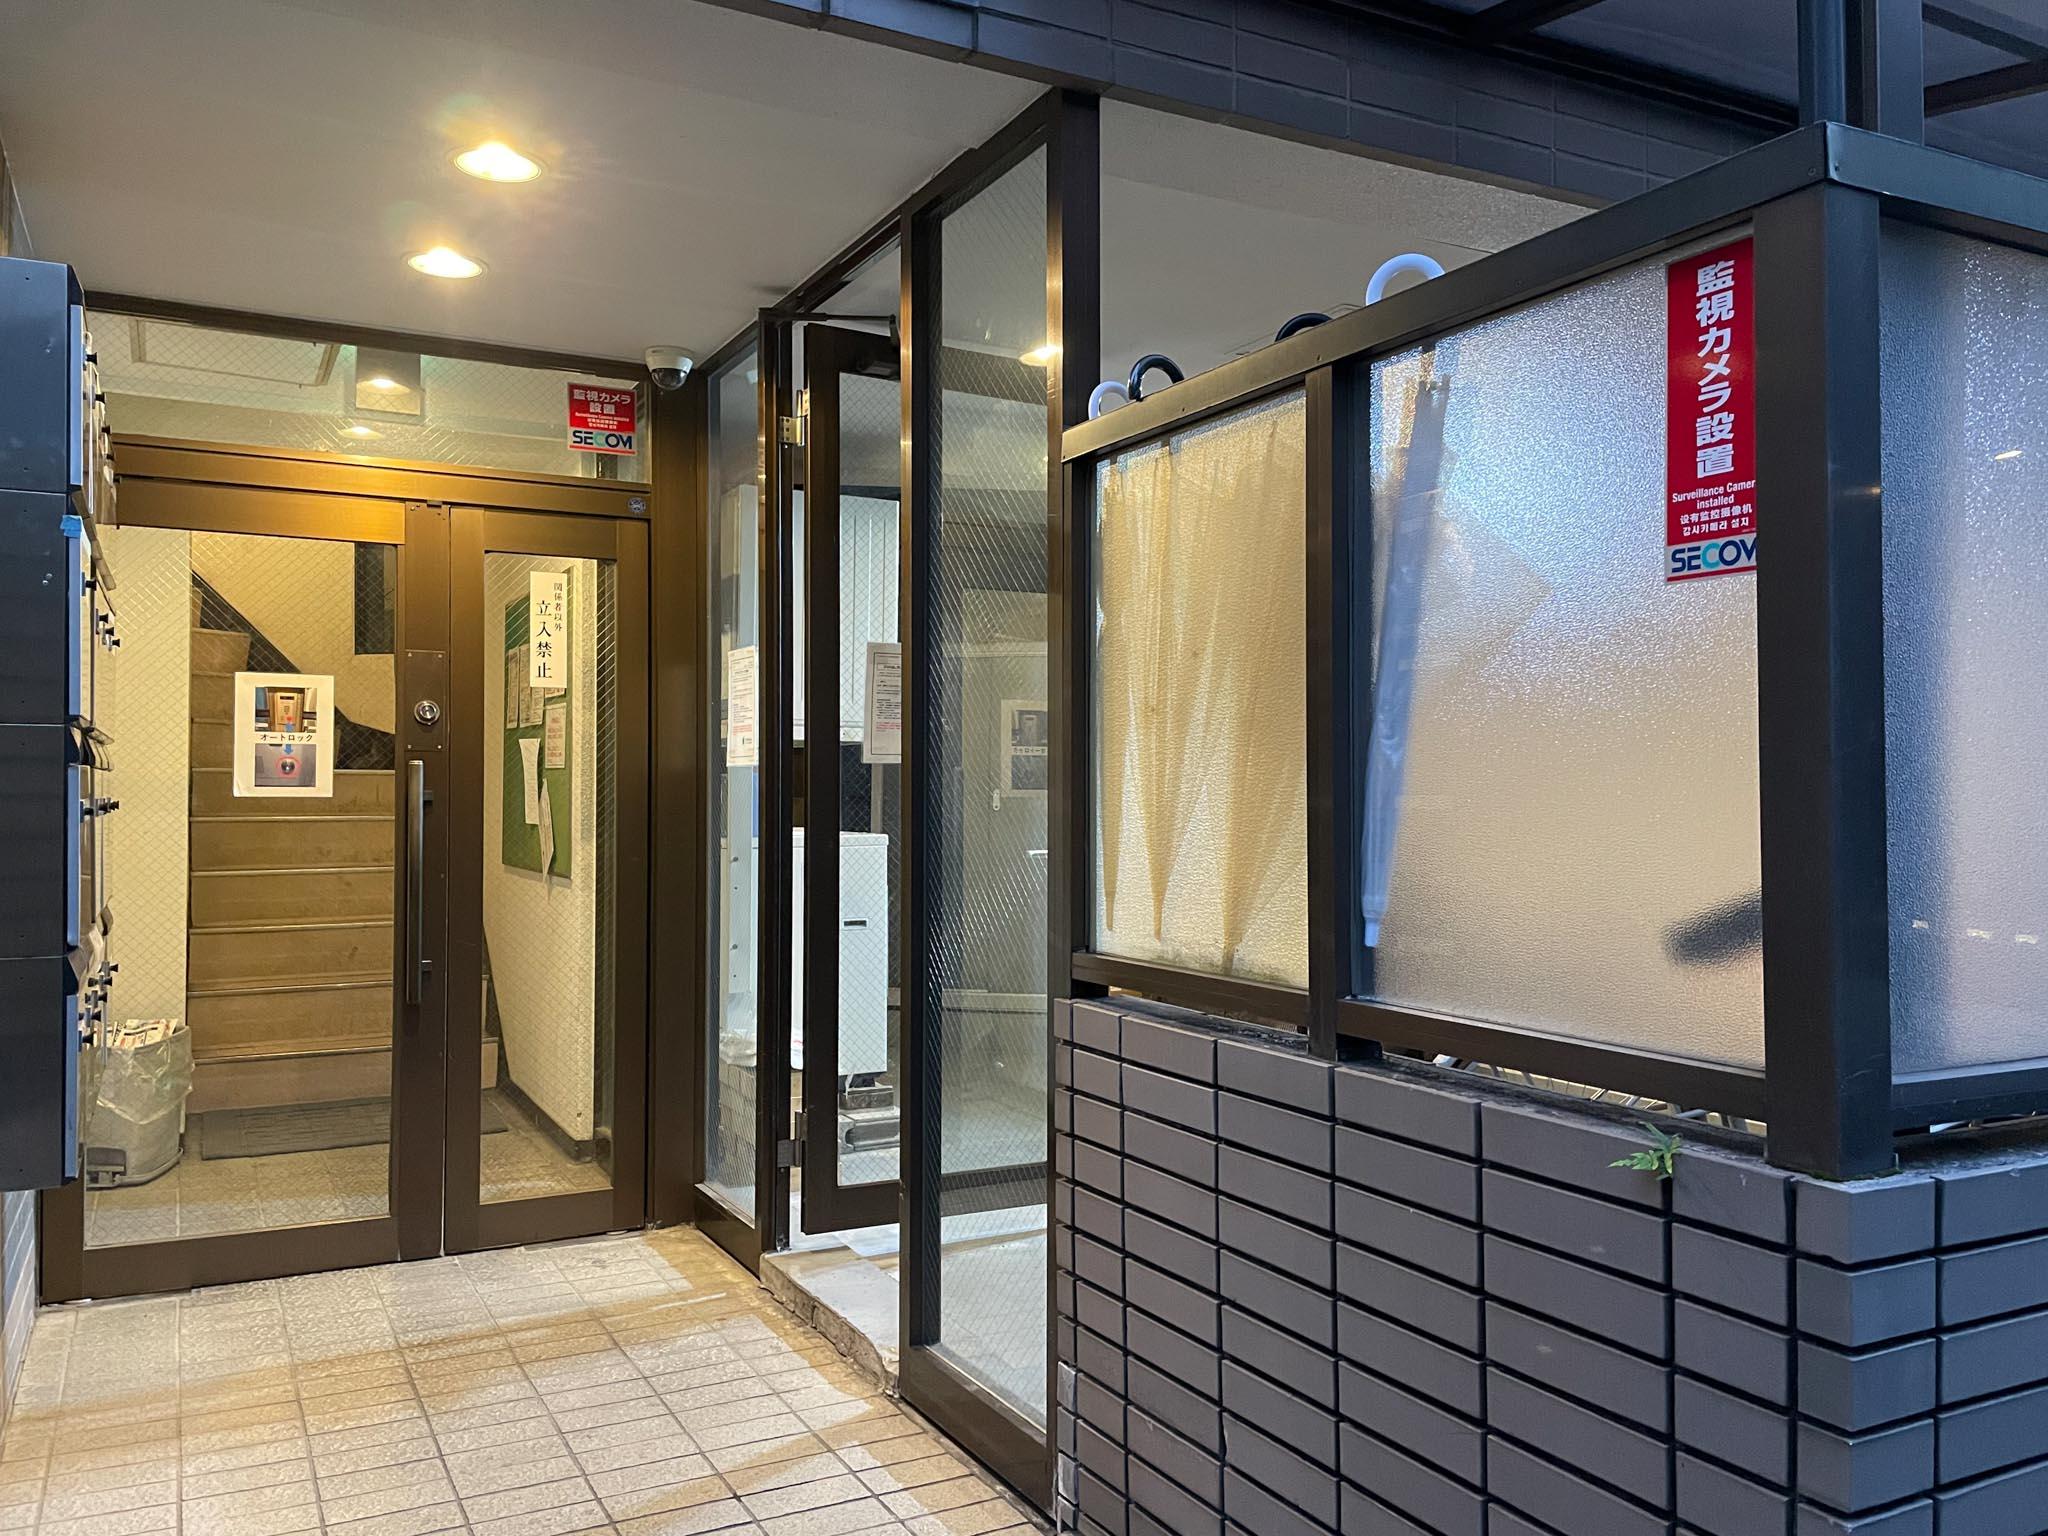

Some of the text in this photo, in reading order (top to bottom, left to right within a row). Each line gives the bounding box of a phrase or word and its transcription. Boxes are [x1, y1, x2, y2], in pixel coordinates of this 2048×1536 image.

[1696, 259, 1735, 479] 監視カメラ設置
[573, 389, 631, 404] 監視カメラ
[572, 430, 633, 450] SECOM
[1672, 479, 1756, 503] Surveillance Camer
[1696, 493, 1735, 510] installed
[553, 582, 563, 632] 関係者以外
[536, 600, 553, 679] 立入禁止
[260, 733, 313, 743] オートロック
